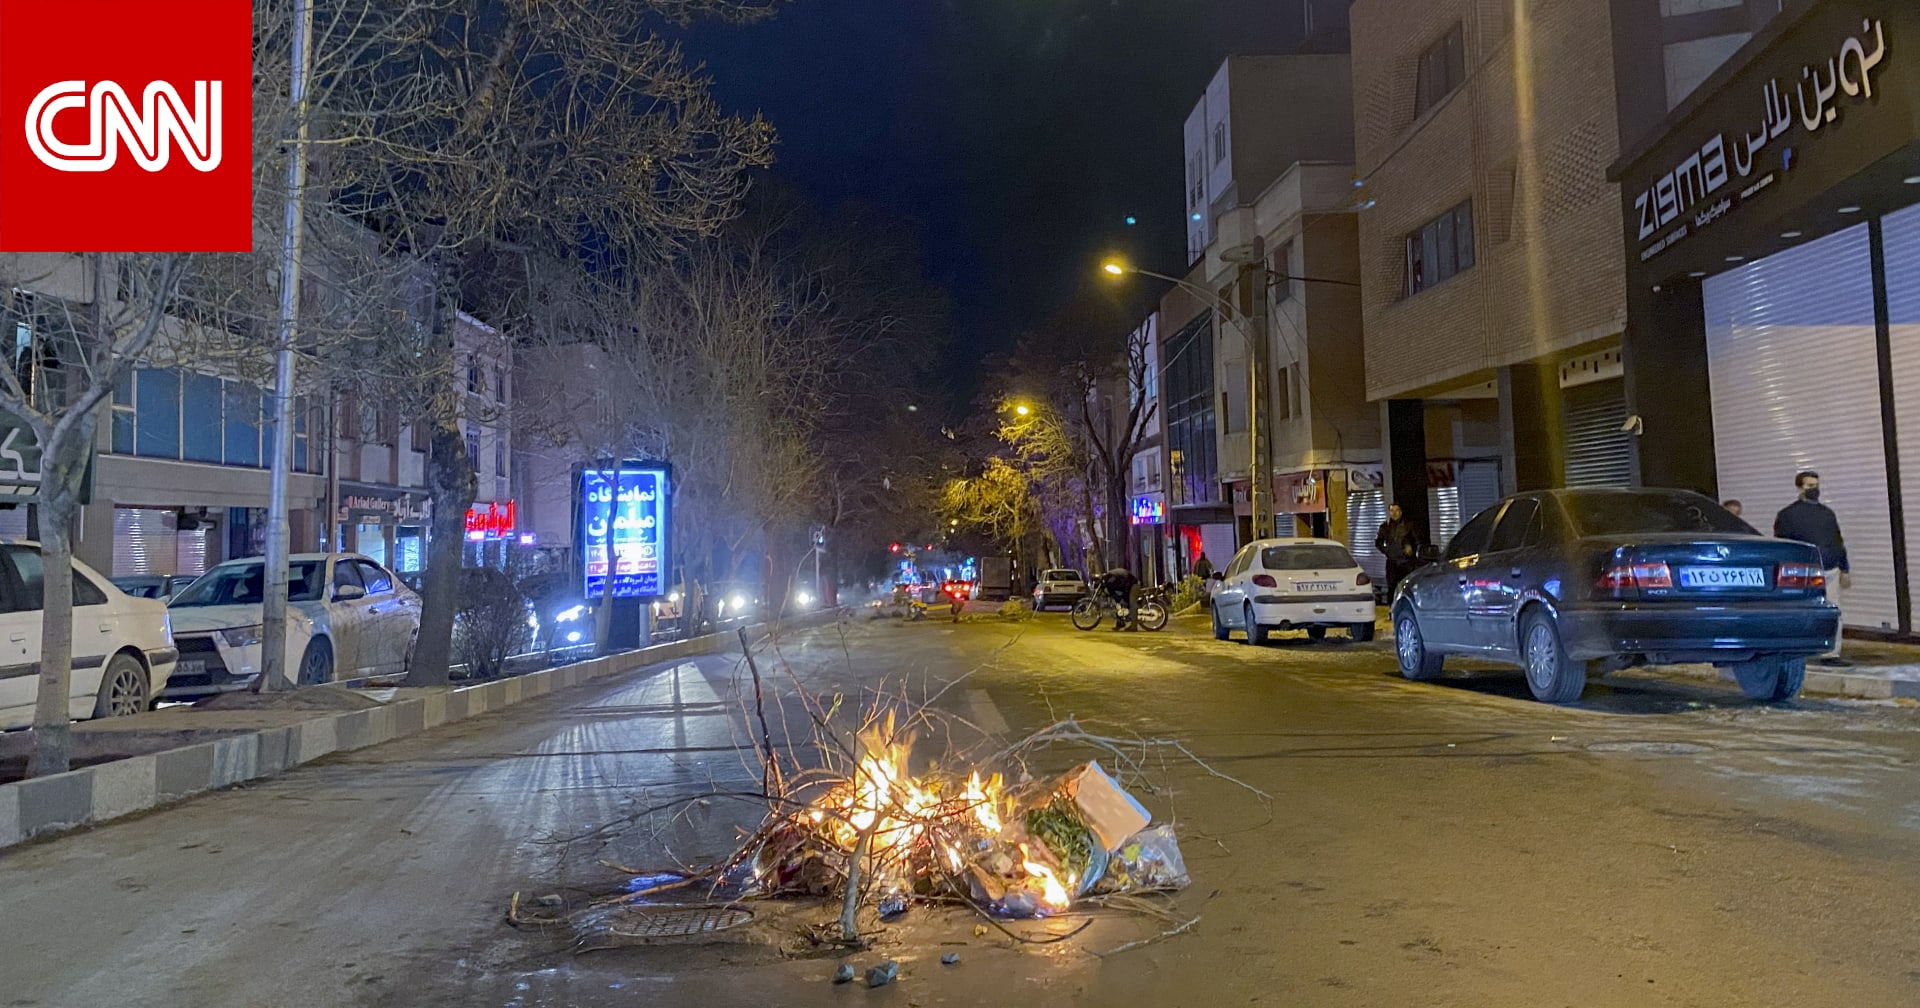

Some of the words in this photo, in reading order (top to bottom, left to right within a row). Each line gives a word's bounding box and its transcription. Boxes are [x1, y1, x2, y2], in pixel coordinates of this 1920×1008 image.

[1797, 18, 1885, 132] نوین
[588, 484, 655, 506] نمایشگاه
[1721, 571, 1745, 584] ۲۶۴
